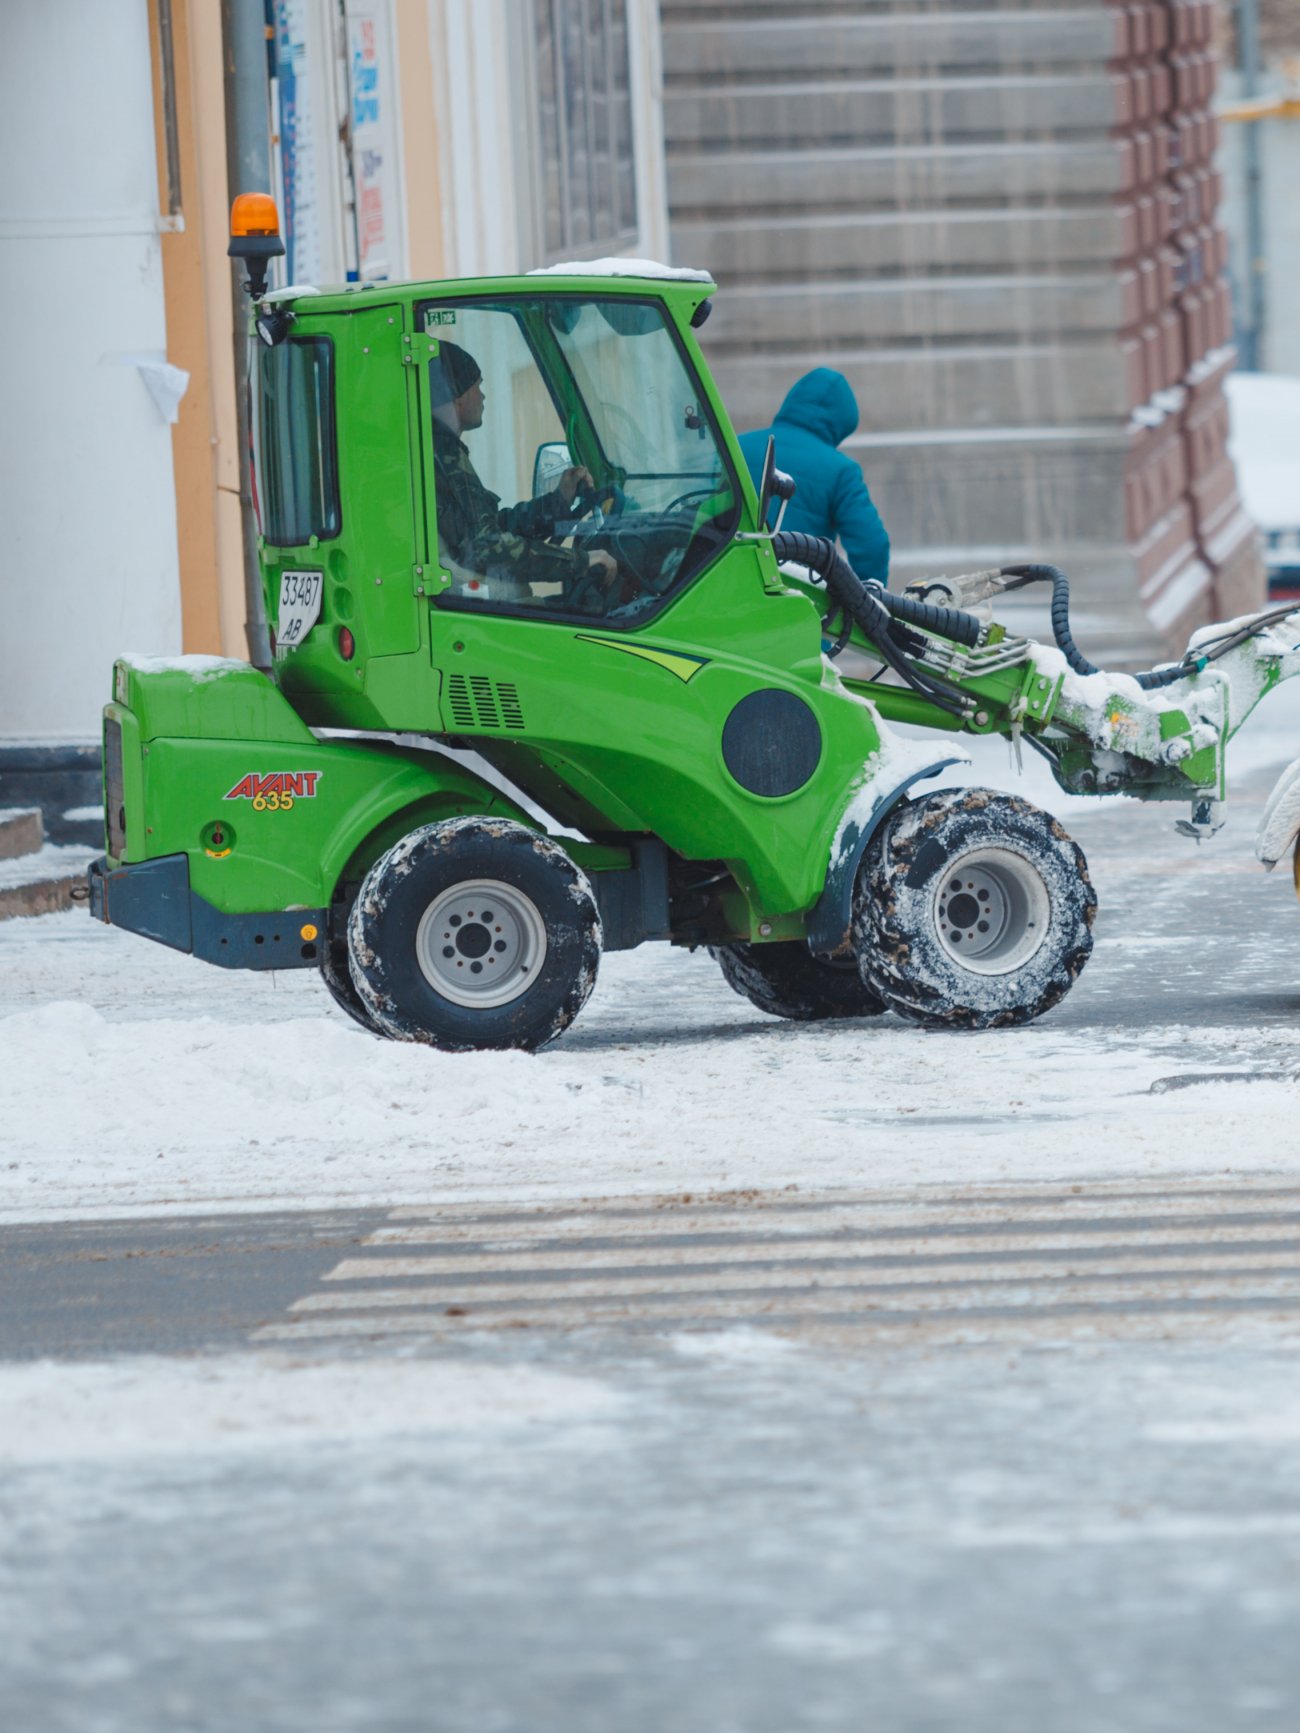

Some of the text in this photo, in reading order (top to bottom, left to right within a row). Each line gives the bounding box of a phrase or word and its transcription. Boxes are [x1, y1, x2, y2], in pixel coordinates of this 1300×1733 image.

[282, 575, 320, 607] 33487
[224, 772, 320, 799] AVANT
[252, 790, 294, 812] 635
